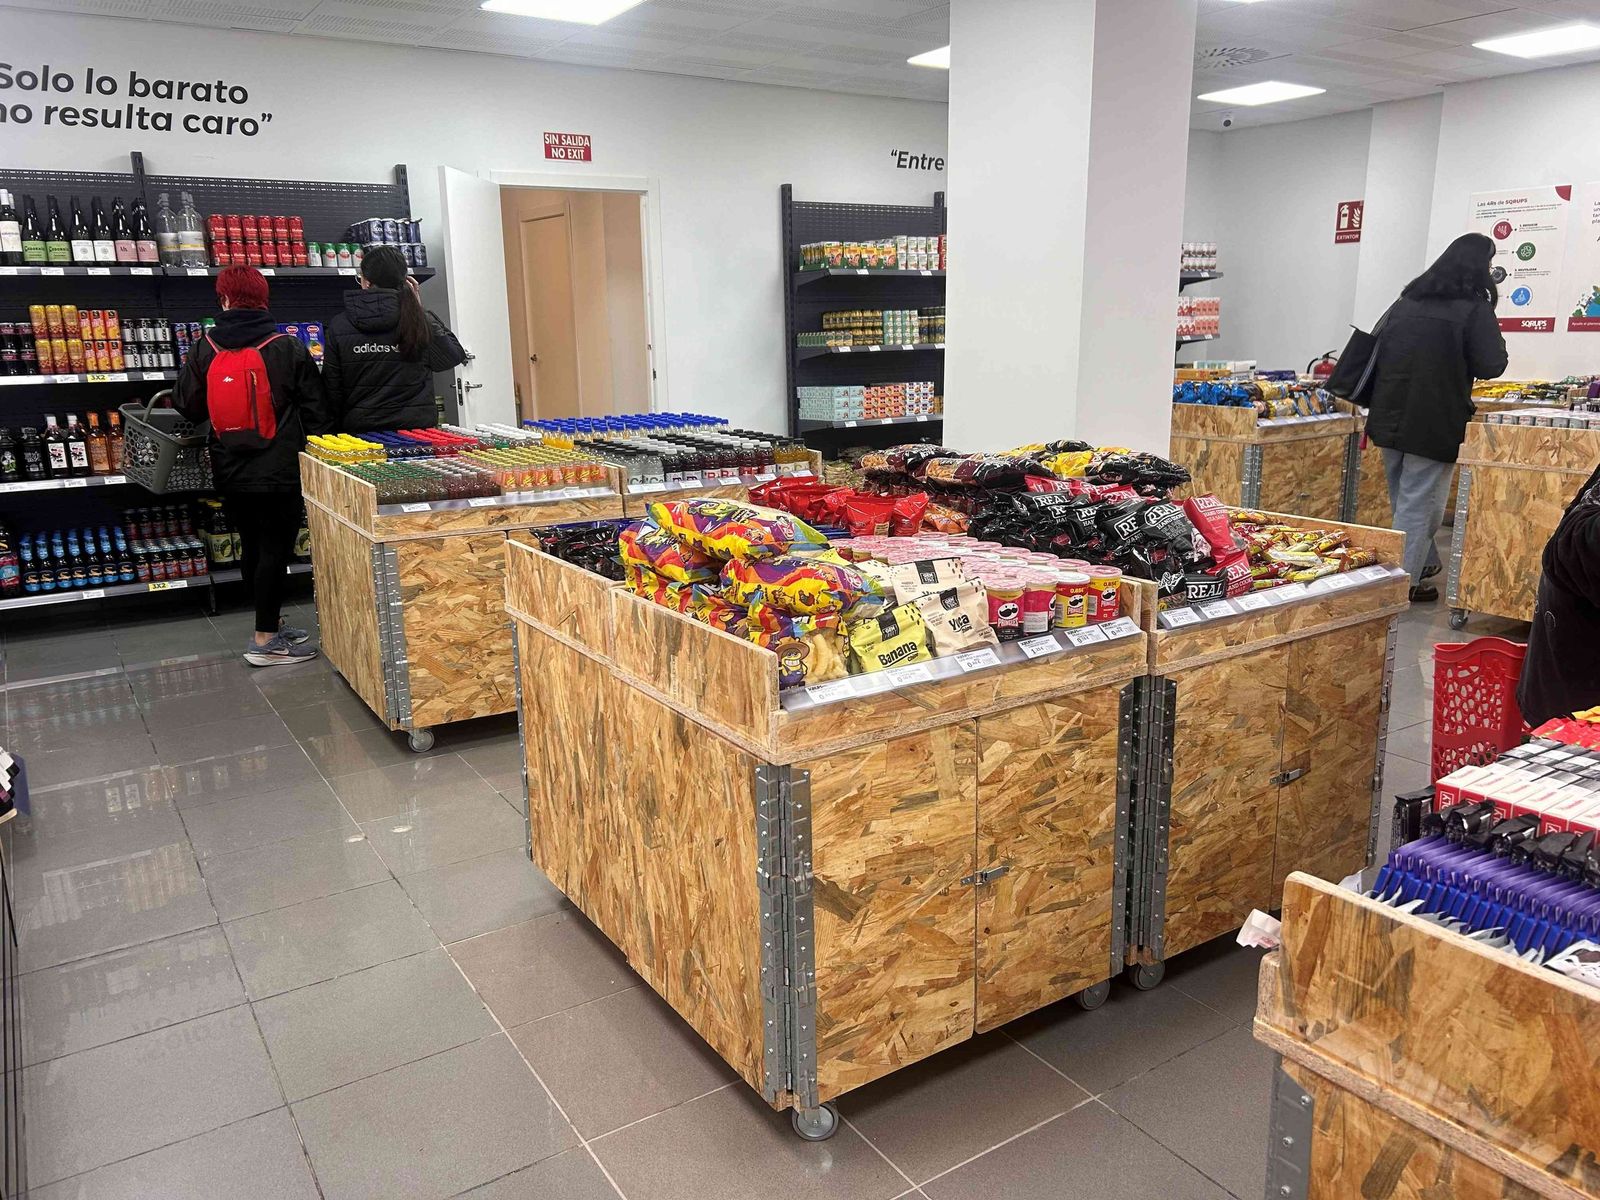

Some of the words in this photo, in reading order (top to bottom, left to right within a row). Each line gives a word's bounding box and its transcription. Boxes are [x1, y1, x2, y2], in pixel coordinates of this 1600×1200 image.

[0, 62, 75, 93] Solo
[85, 67, 118, 96] lo
[128, 71, 249, 105] barato
[44, 103, 173, 132] resulta
[544, 133, 559, 145] SIN
[561, 134, 590, 147] SALIDA
[551, 147, 566, 158] NO
[567, 148, 585, 160] EXIT
[352, 342, 391, 354] adidas
[1119, 516, 1139, 537] RE
[1186, 583, 1223, 600] REAL
[877, 641, 918, 666] Banana
